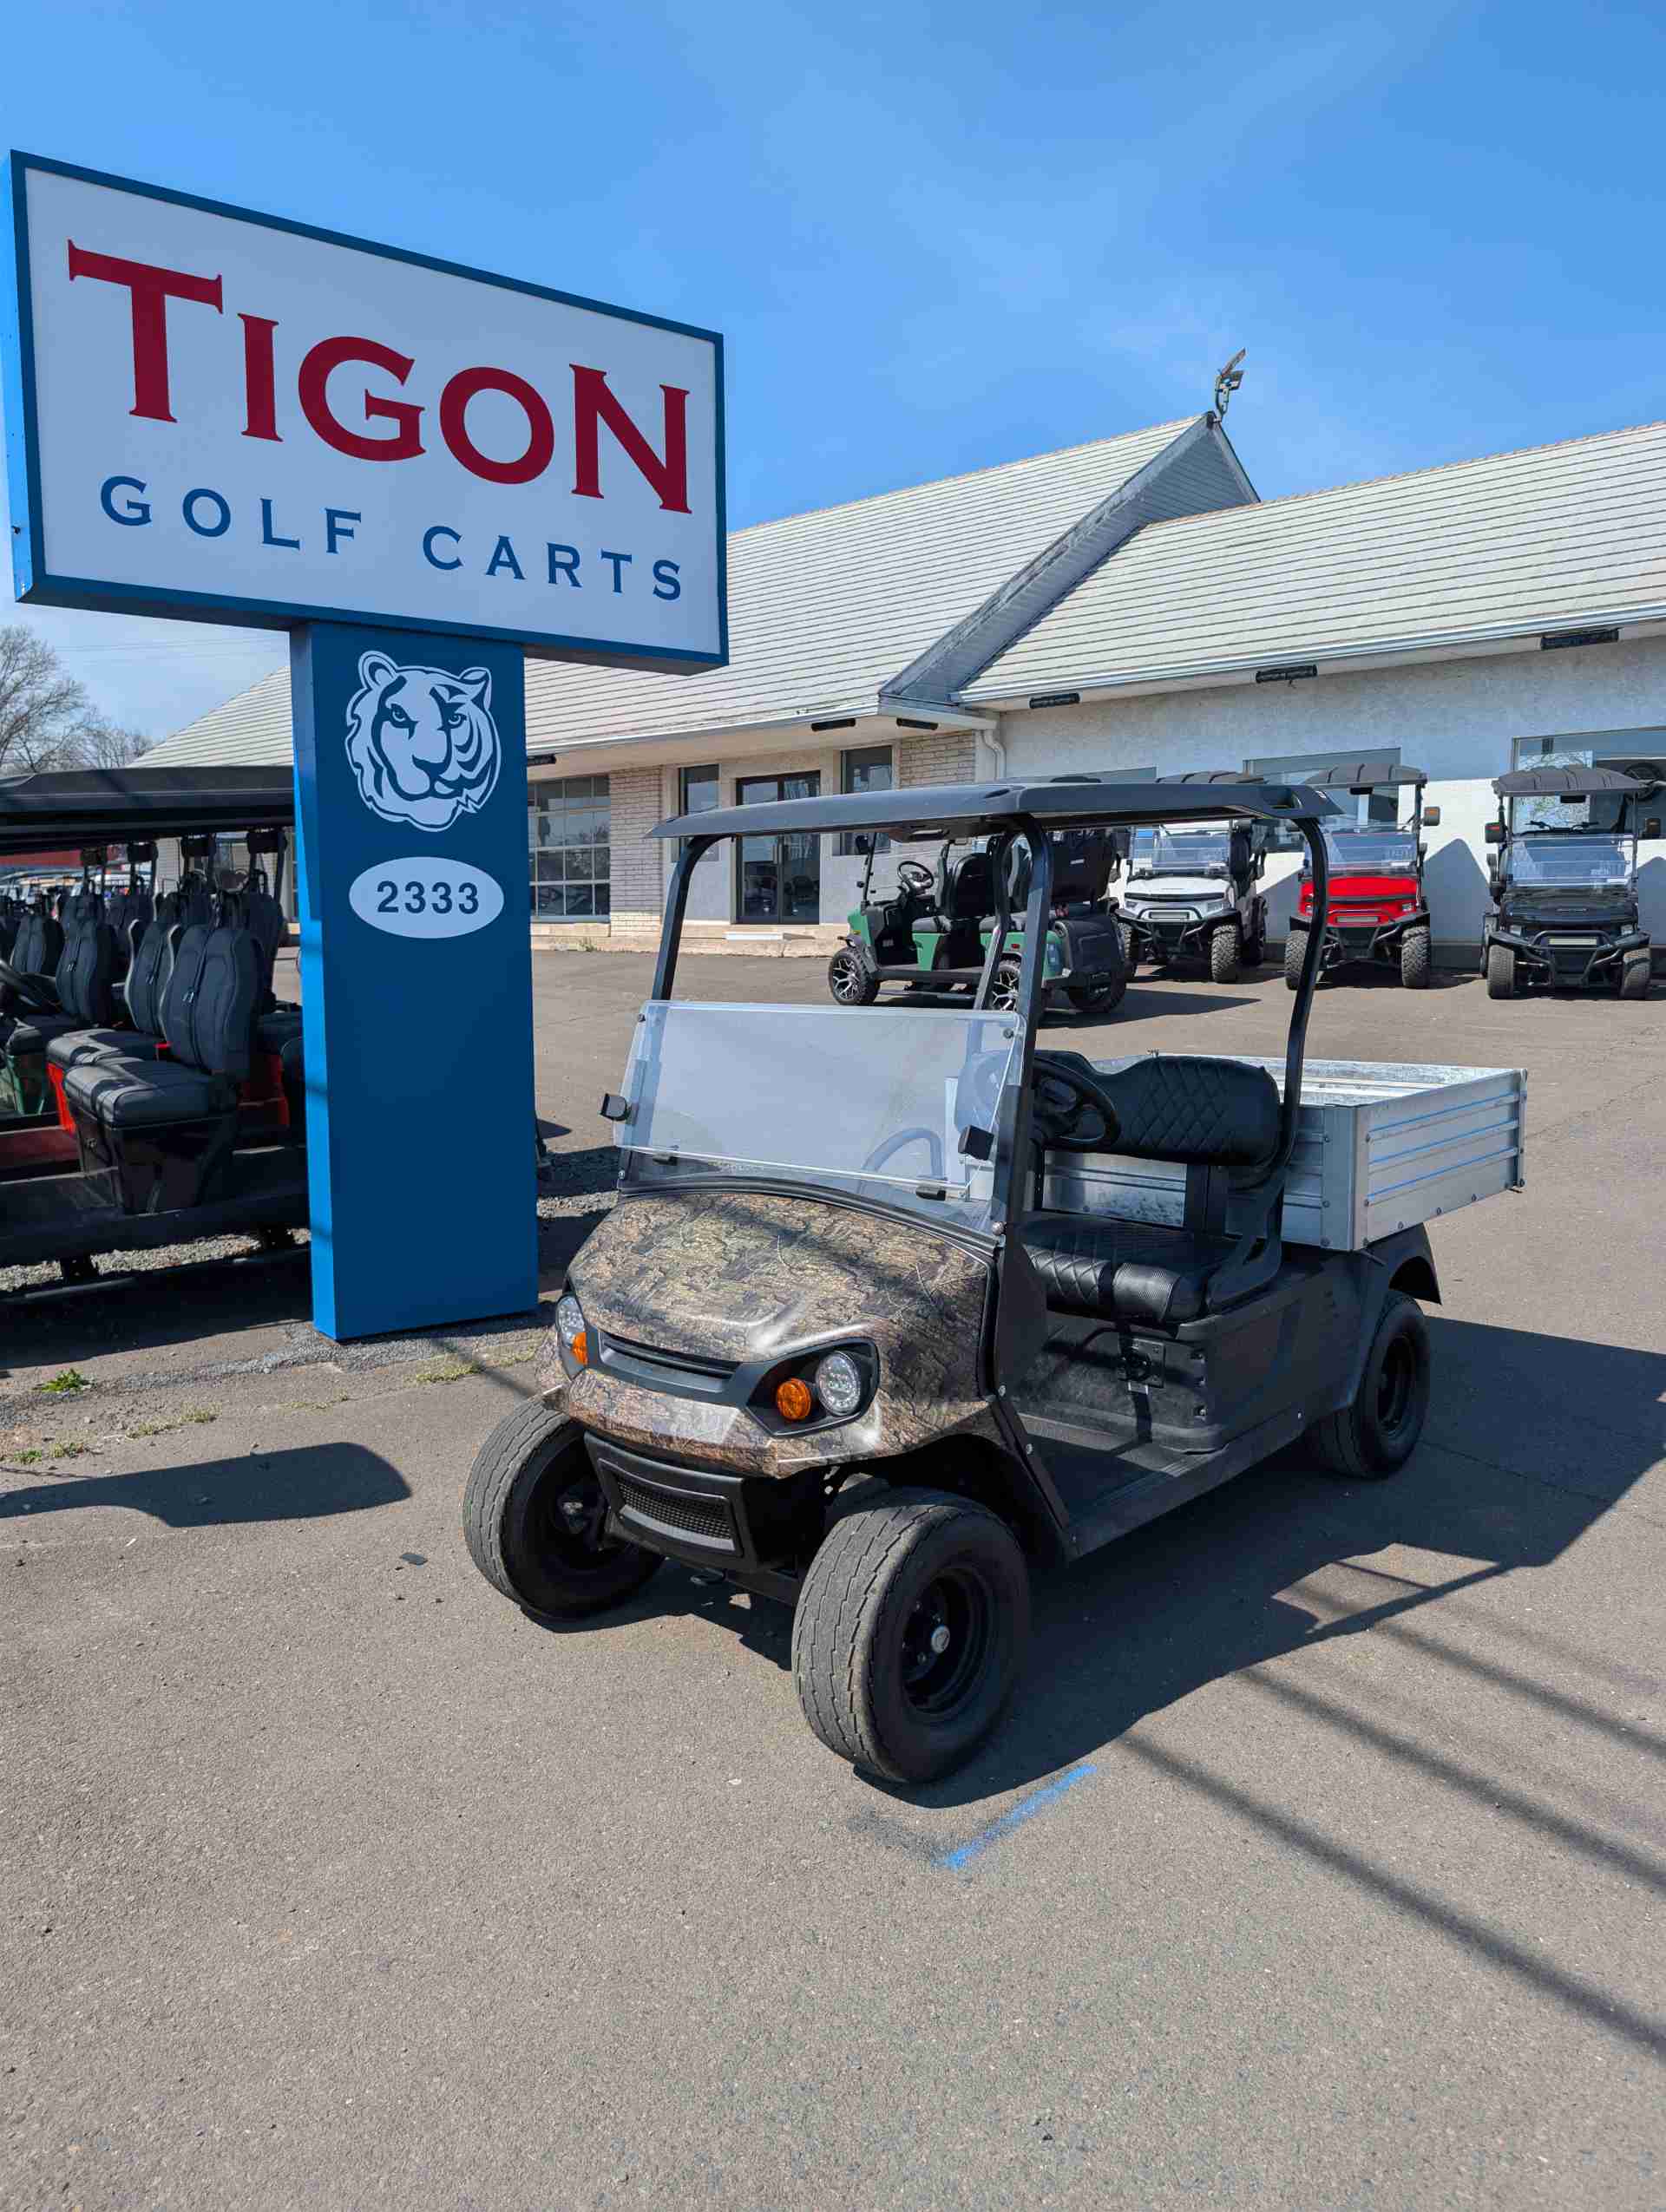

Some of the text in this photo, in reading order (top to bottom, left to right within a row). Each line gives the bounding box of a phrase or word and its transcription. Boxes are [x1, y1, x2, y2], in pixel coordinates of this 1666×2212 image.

[68, 239, 692, 514] TIGON
[101, 476, 681, 601] GOLF CARTS
[377, 880, 479, 915] 2333
